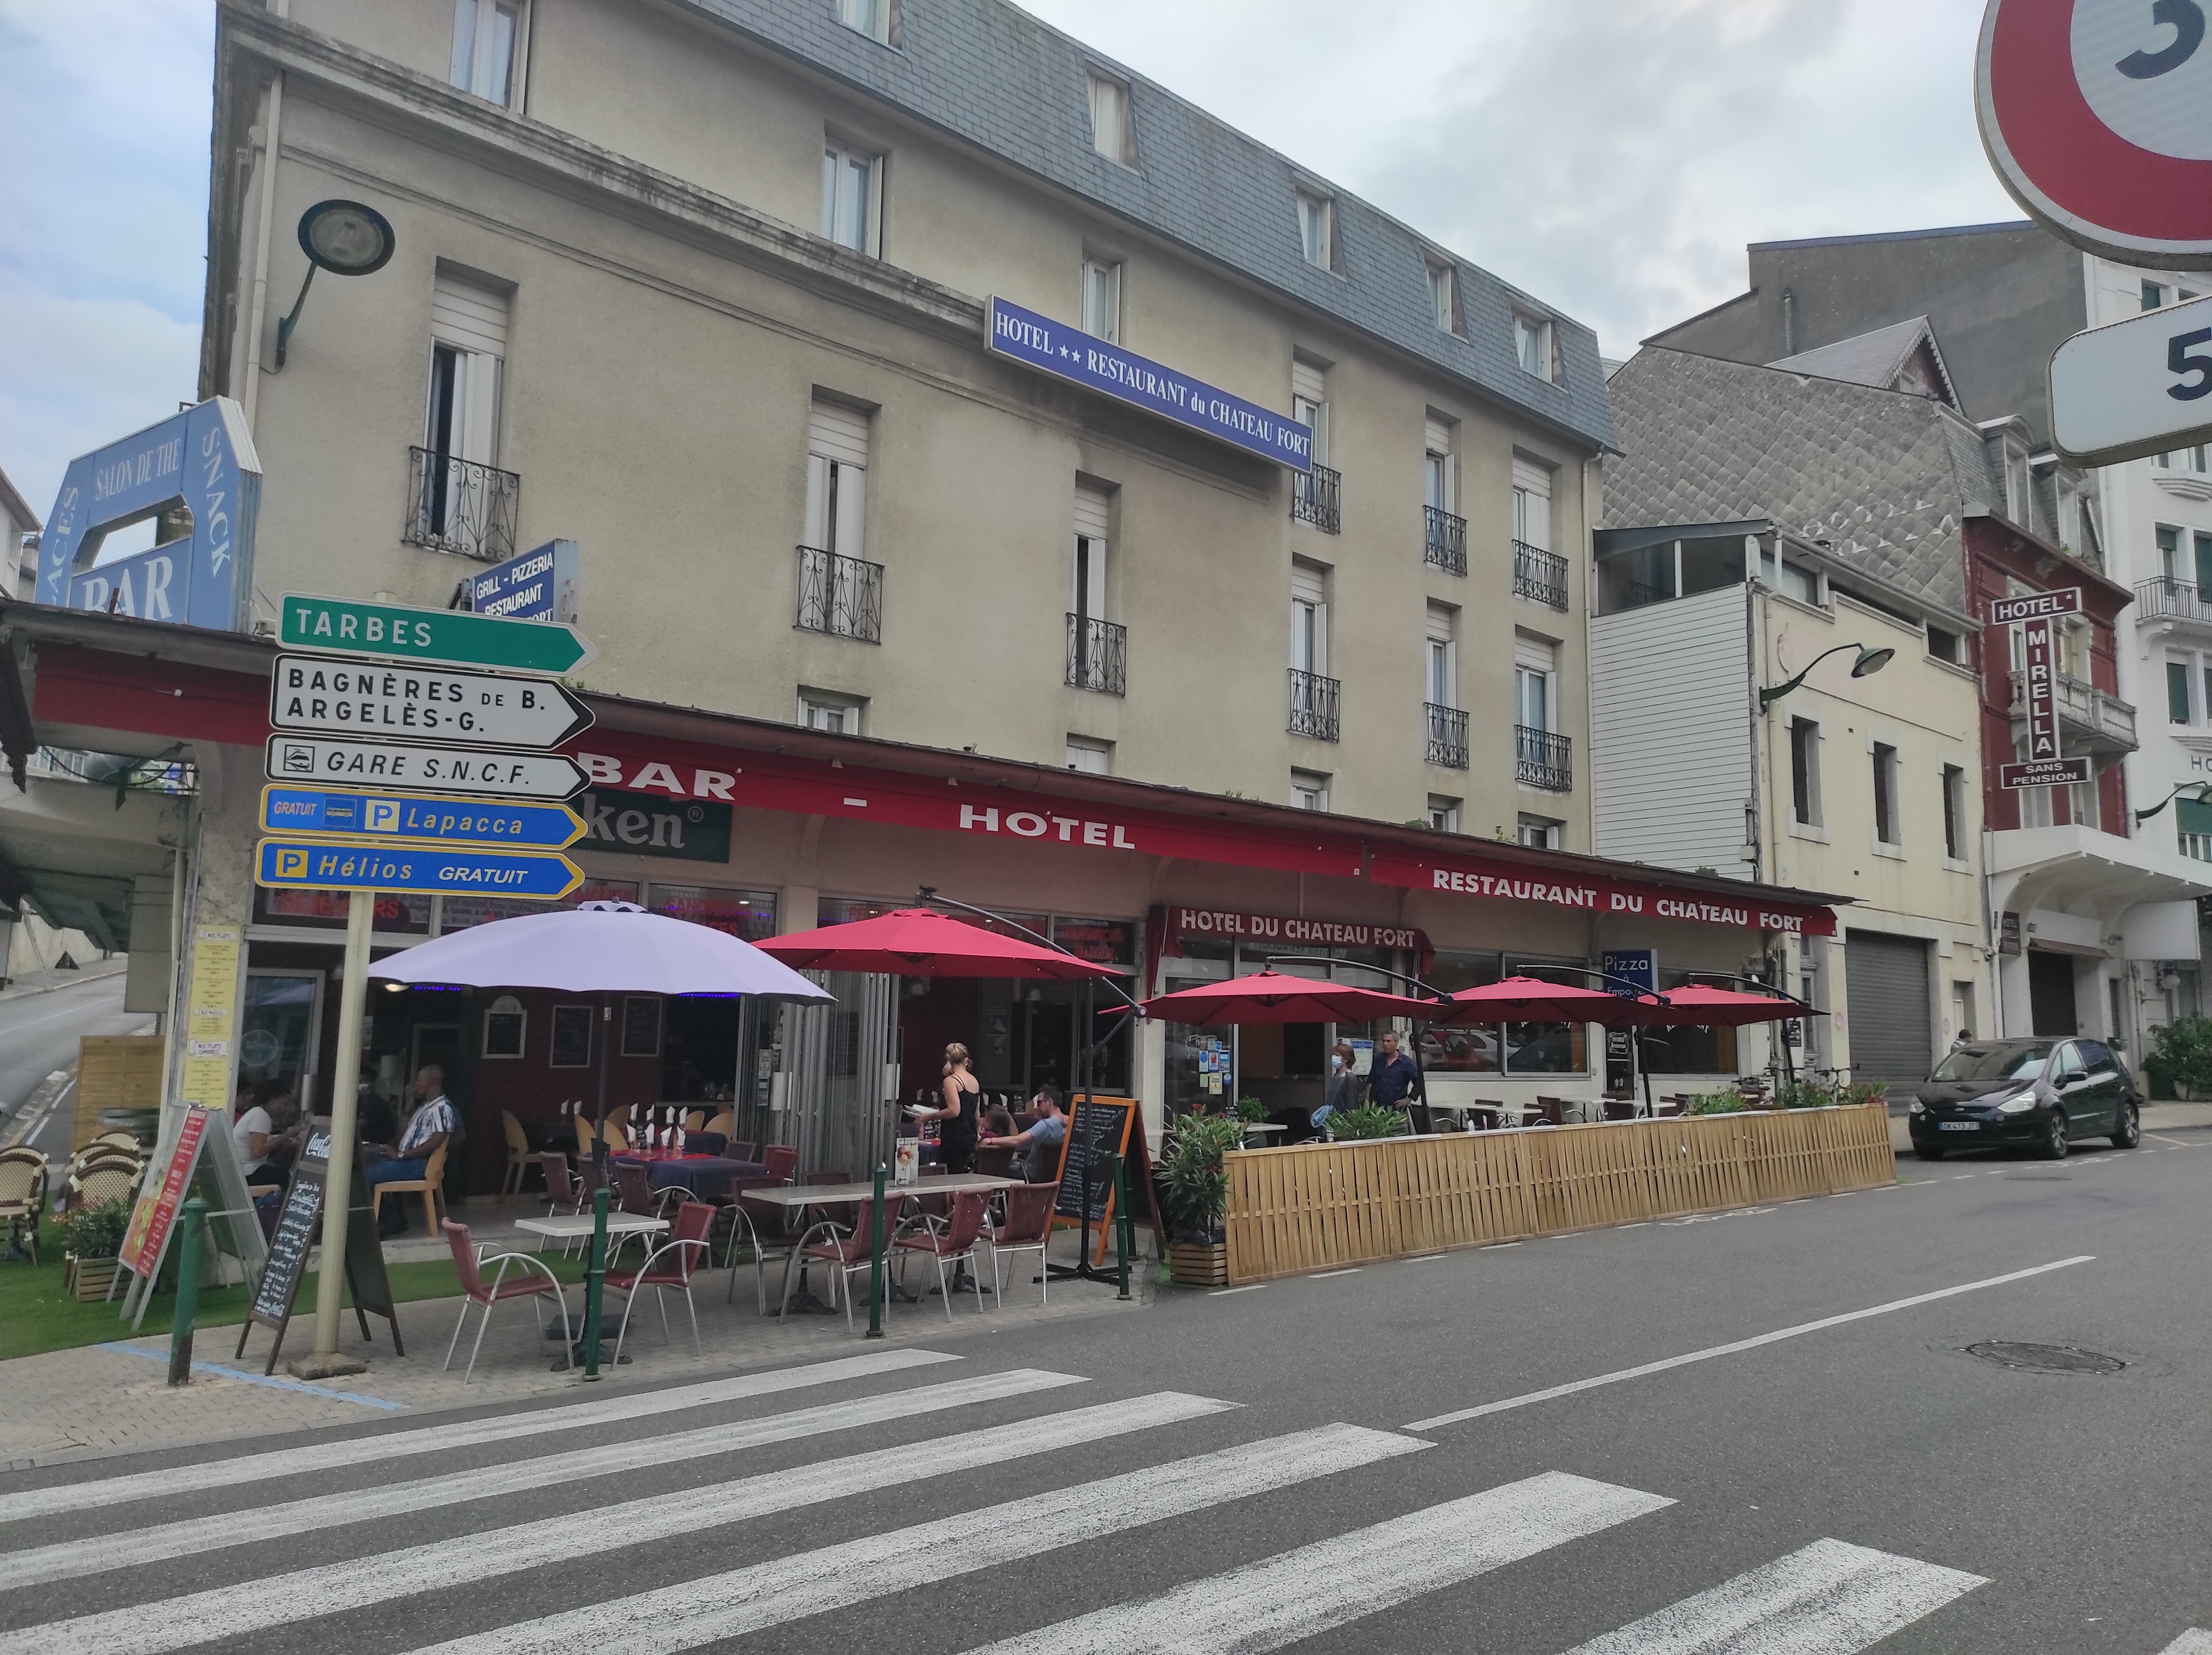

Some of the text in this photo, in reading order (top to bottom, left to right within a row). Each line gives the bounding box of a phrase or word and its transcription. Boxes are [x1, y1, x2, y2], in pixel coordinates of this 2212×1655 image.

[995, 311, 1311, 458] HOTEL RESTAURANT du CHATEAU FORT
[2167, 327, 2212, 401] 5
[96, 438, 181, 501] SALON DE THE
[203, 427, 231, 578] SNACK
[48, 487, 79, 604] ACES
[83, 556, 174, 621] BAR
[477, 576, 501, 600] GRILL
[512, 552, 553, 585] PIZZERIA
[485, 582, 543, 616] RESTAURANT
[1999, 596, 2064, 620] HOTEL
[296, 608, 432, 647] TARBES
[288, 669, 545, 710] BAGNÈRES DE B.
[2028, 629, 2052, 753] MIRELLA
[327, 752, 529, 785] GARE S.N.C.F.
[2012, 772, 2077, 785] PENSION
[2025, 763, 2063, 774] SANS
[274, 801, 317, 816] GRATUIT
[407, 807, 523, 839] Lapacca
[578, 751, 736, 801] BAR
[959, 804, 1136, 849] HOTEL
[318, 855, 413, 879] Hélios
[439, 866, 528, 884] GRATUIT
[1434, 869, 1803, 932] RESTAURANT DU CHATEAU FORT
[1181, 909, 1415, 948] HOTEL DU CHATEAU FORT
[1605, 956, 1648, 971] Pizza
